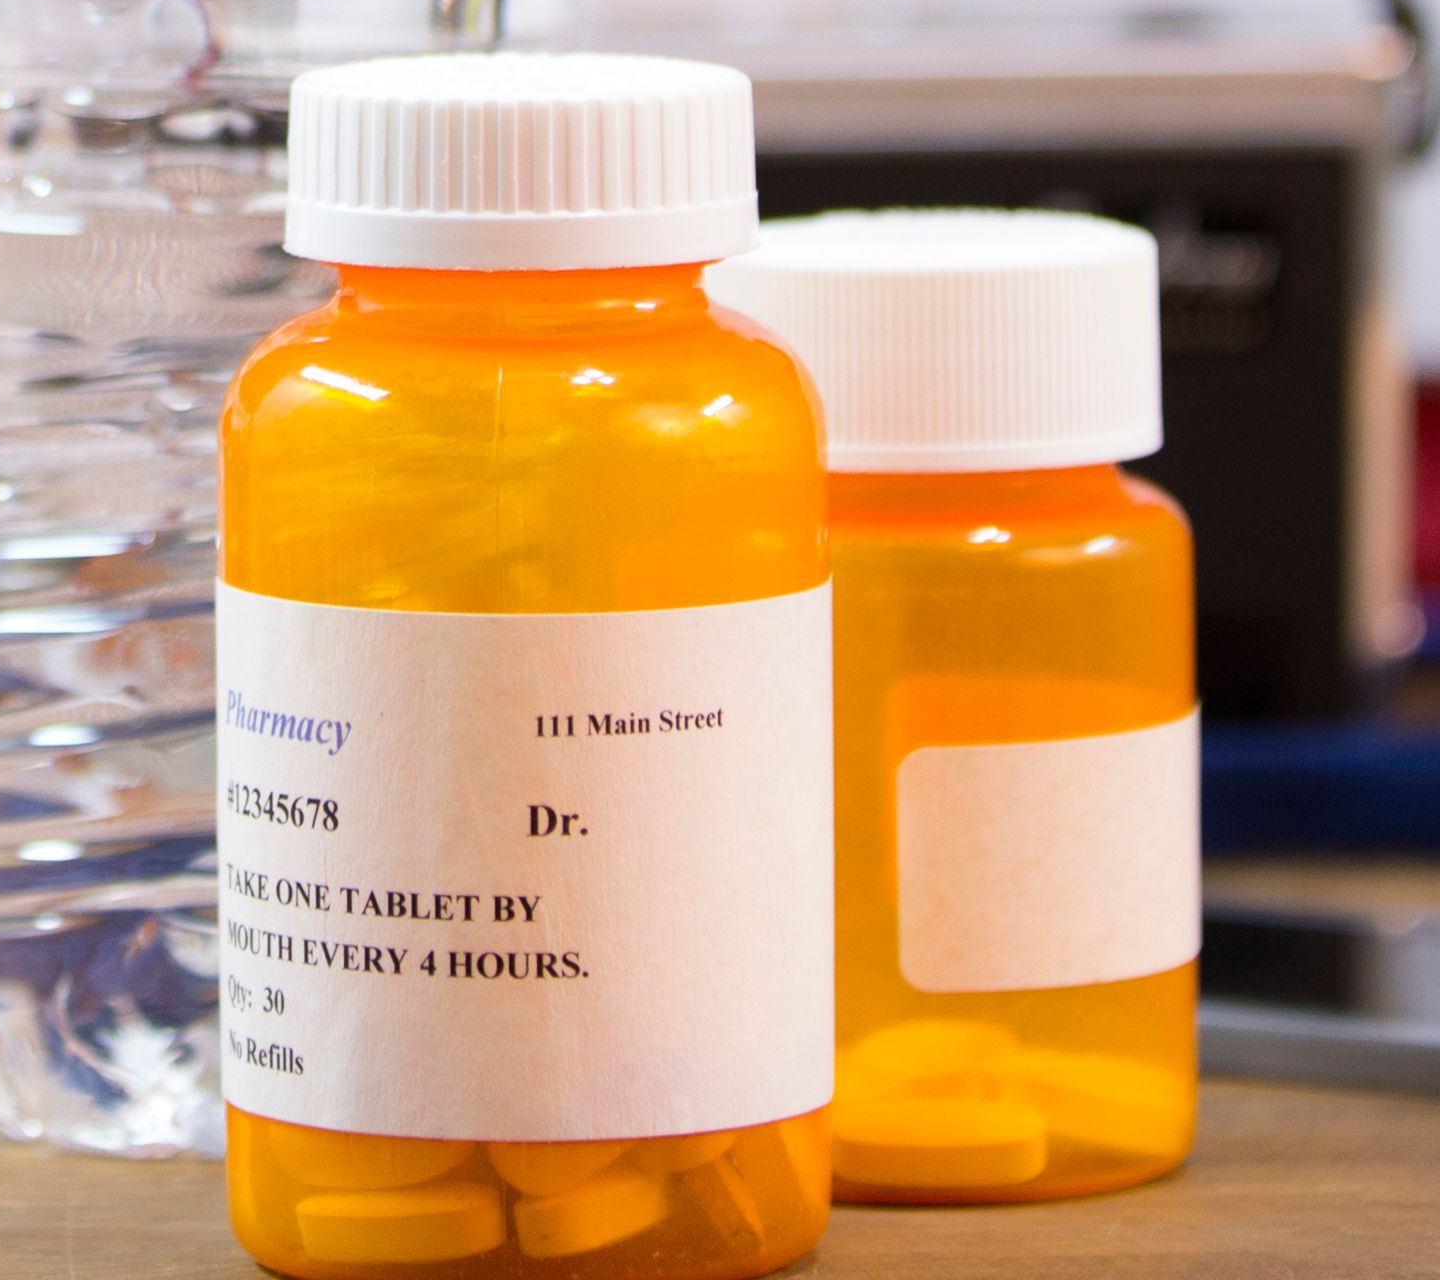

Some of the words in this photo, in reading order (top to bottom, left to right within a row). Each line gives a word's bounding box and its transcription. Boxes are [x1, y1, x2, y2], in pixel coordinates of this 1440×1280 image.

[226, 689, 352, 756] Pharmacy
[535, 715, 575, 738] 111
[587, 713, 650, 736] Main
[659, 707, 724, 733] Street
[227, 779, 339, 832] #12345678
[526, 804, 589, 837] Dr.
[226, 863, 269, 901] TAKE
[275, 878, 330, 912] ONE
[339, 887, 480, 922] TABLET
[492, 895, 542, 922] BY
[227, 919, 293, 962] MOUTH
[303, 939, 408, 975] EVERY
[420, 949, 437, 977] 4
[448, 951, 589, 980] HOURS.
[228, 973, 252, 1012] Qty:
[262, 986, 285, 1016] 30
[229, 1028, 242, 1060] No
[246, 1037, 304, 1076] Refills
